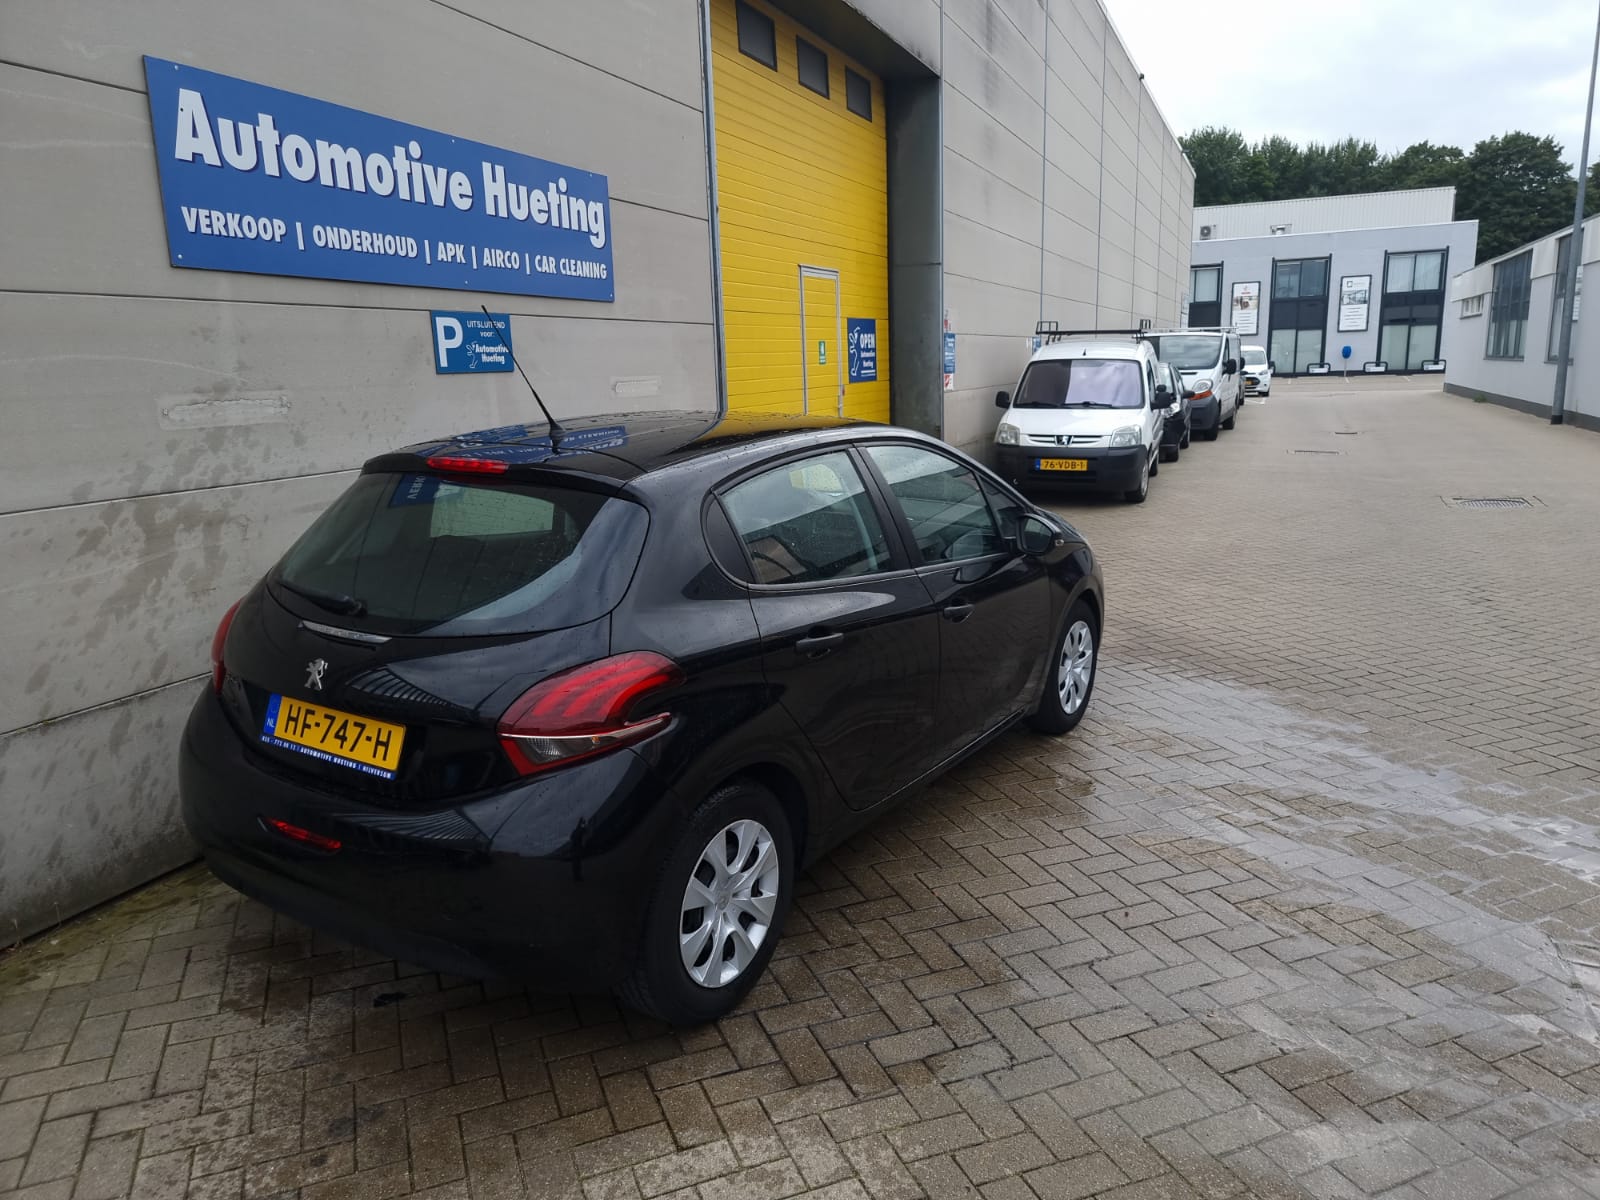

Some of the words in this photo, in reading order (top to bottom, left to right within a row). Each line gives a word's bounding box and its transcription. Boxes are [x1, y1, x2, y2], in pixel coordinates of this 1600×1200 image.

[175, 88, 473, 211] Automotive
[482, 161, 606, 248] Hueting
[181, 206, 287, 242] VERKOOP
[313, 225, 418, 258] ONDERHOUD
[437, 242, 466, 263] APK
[483, 248, 520, 269] AIRCO
[535, 254, 557, 274] CAR
[560, 259, 607, 279] CLEANING
[435, 316, 463, 367] P
[860, 333, 875, 349] OPEN
[284, 704, 392, 761] HF-747-H
